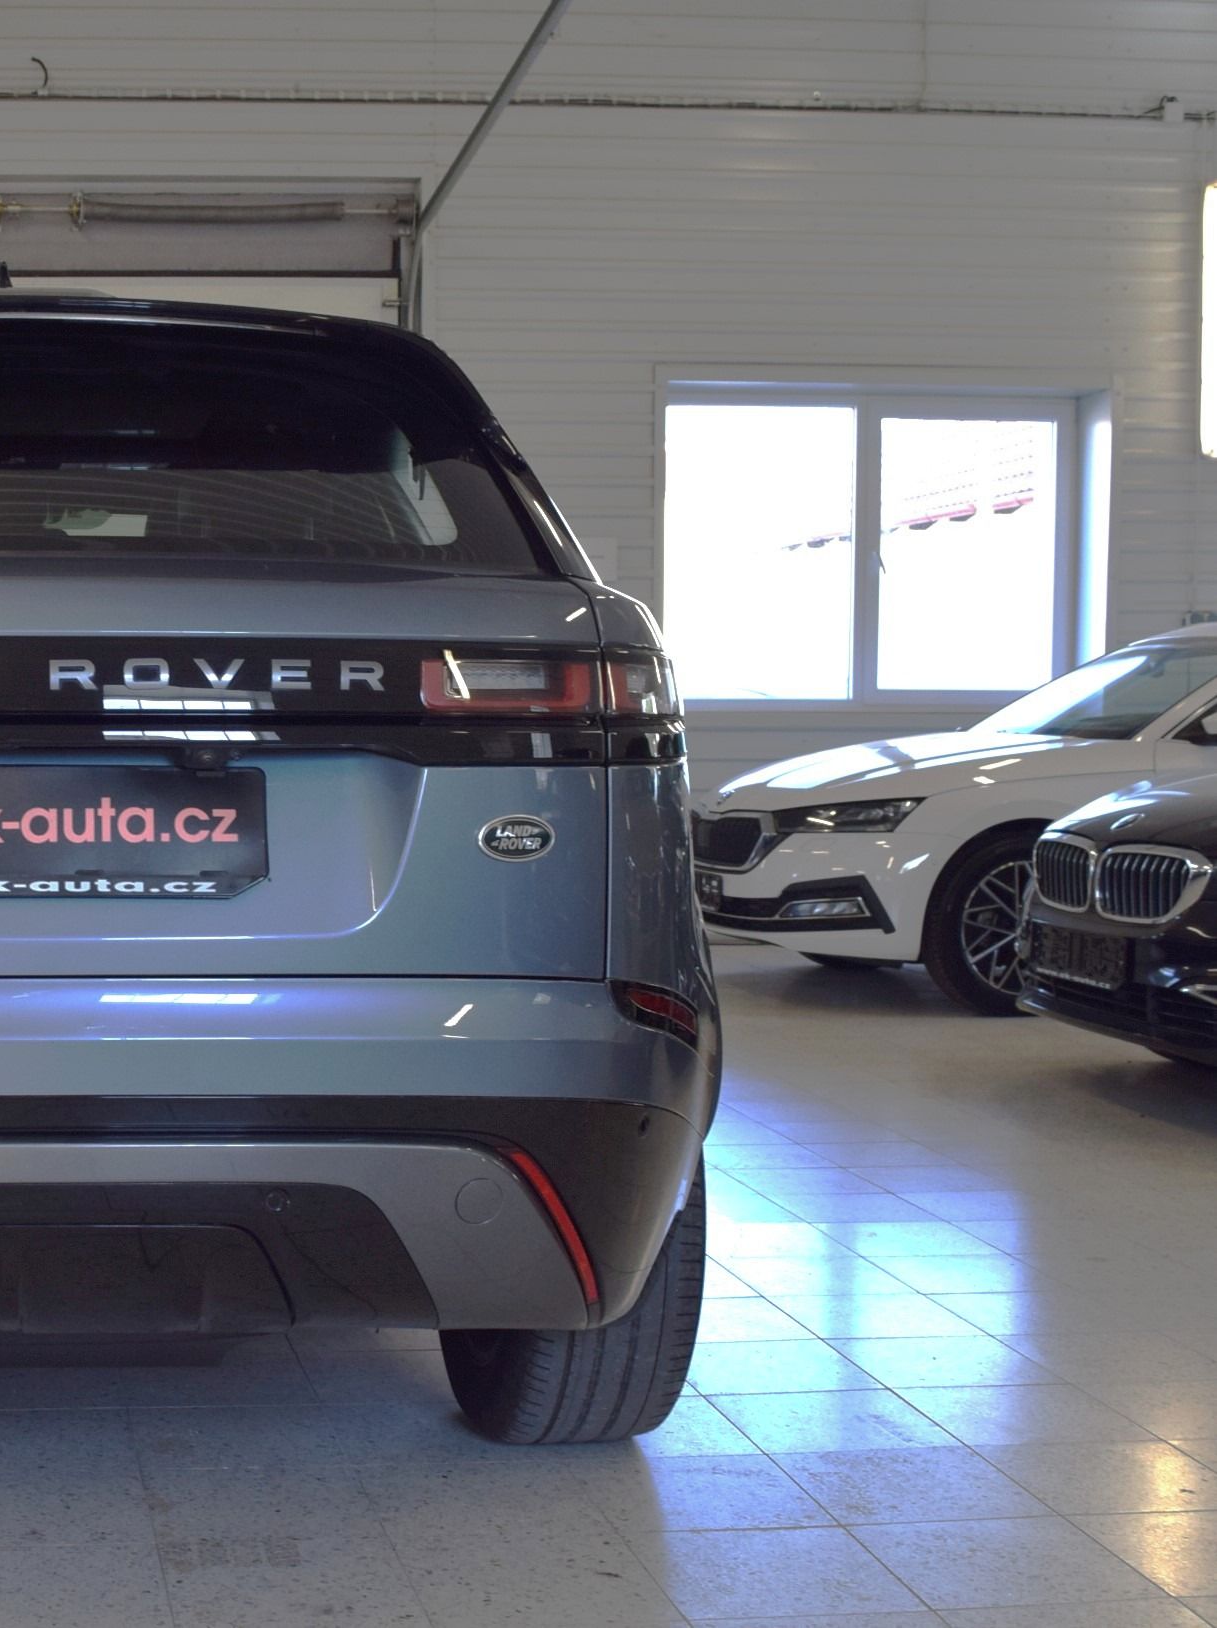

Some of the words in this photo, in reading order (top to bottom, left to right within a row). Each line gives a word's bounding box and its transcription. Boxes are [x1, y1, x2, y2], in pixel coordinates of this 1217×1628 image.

[48, 658, 384, 691] ROVER
[496, 825, 532, 837] LAND
[498, 838, 542, 850] ROVER
